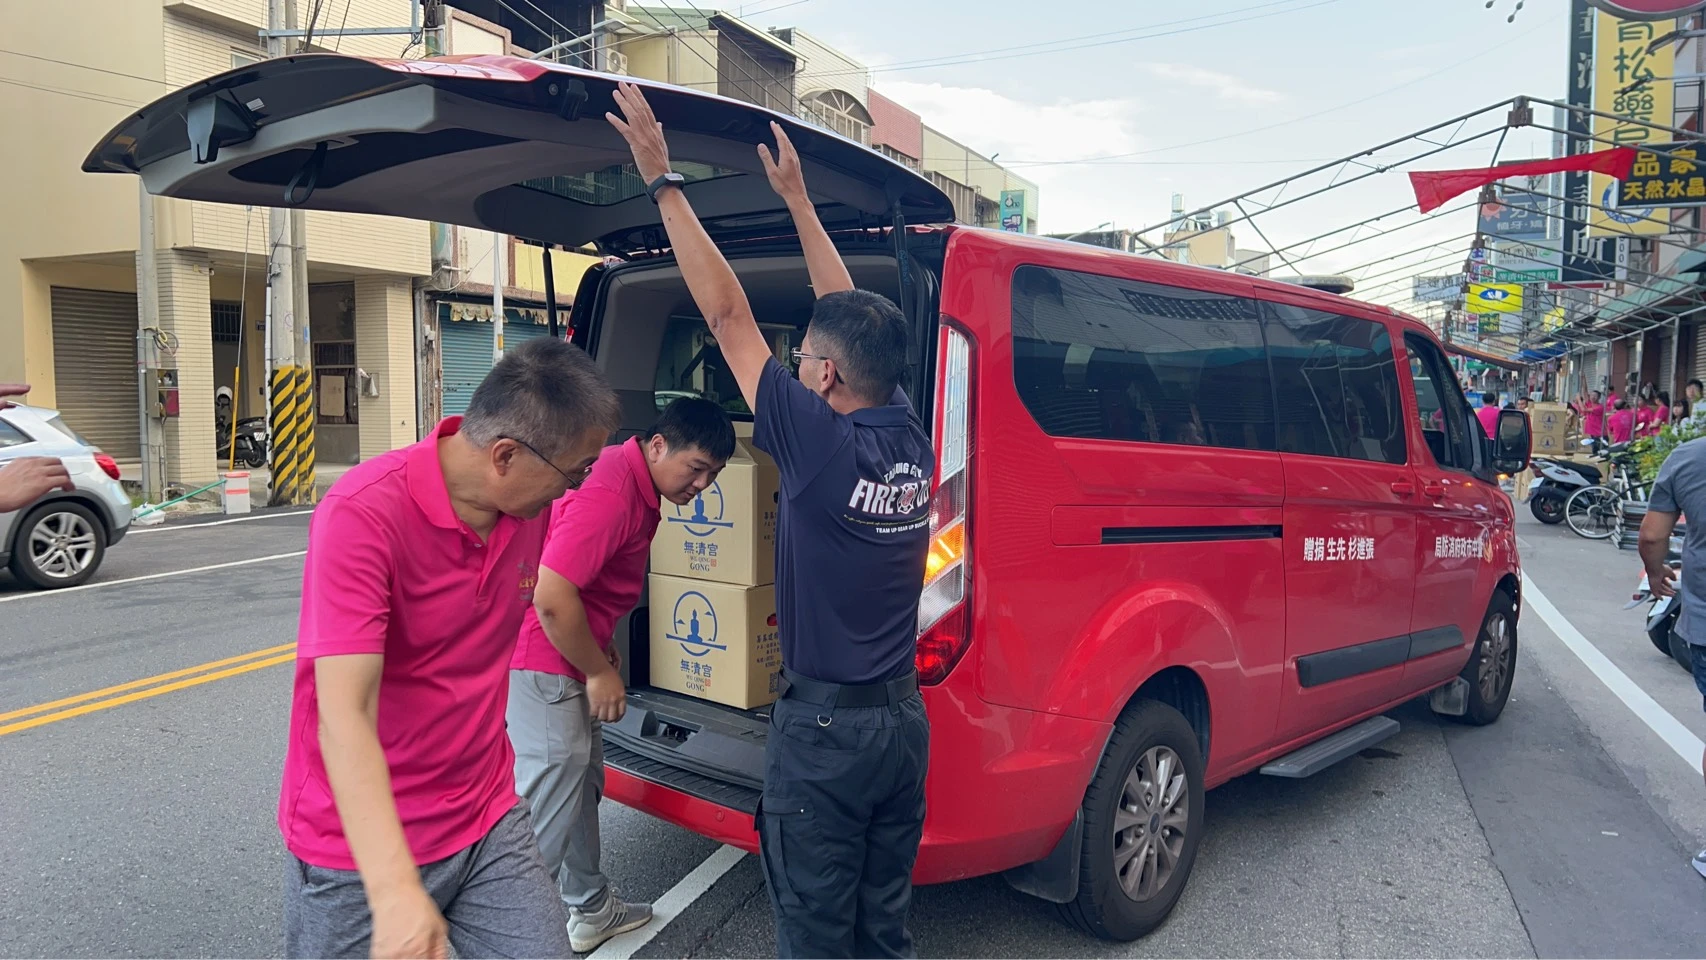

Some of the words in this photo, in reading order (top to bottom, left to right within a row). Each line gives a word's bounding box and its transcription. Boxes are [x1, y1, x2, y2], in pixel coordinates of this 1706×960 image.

[1633, 149, 1697, 177] 品家
[1623, 177, 1705, 201] 天然水晶
[848, 478, 899, 515] FIRE
[683, 540, 718, 557] 無清宮
[689, 562, 710, 572] GONG
[680, 658, 712, 678] 無清宮
[685, 681, 705, 692] GONG
